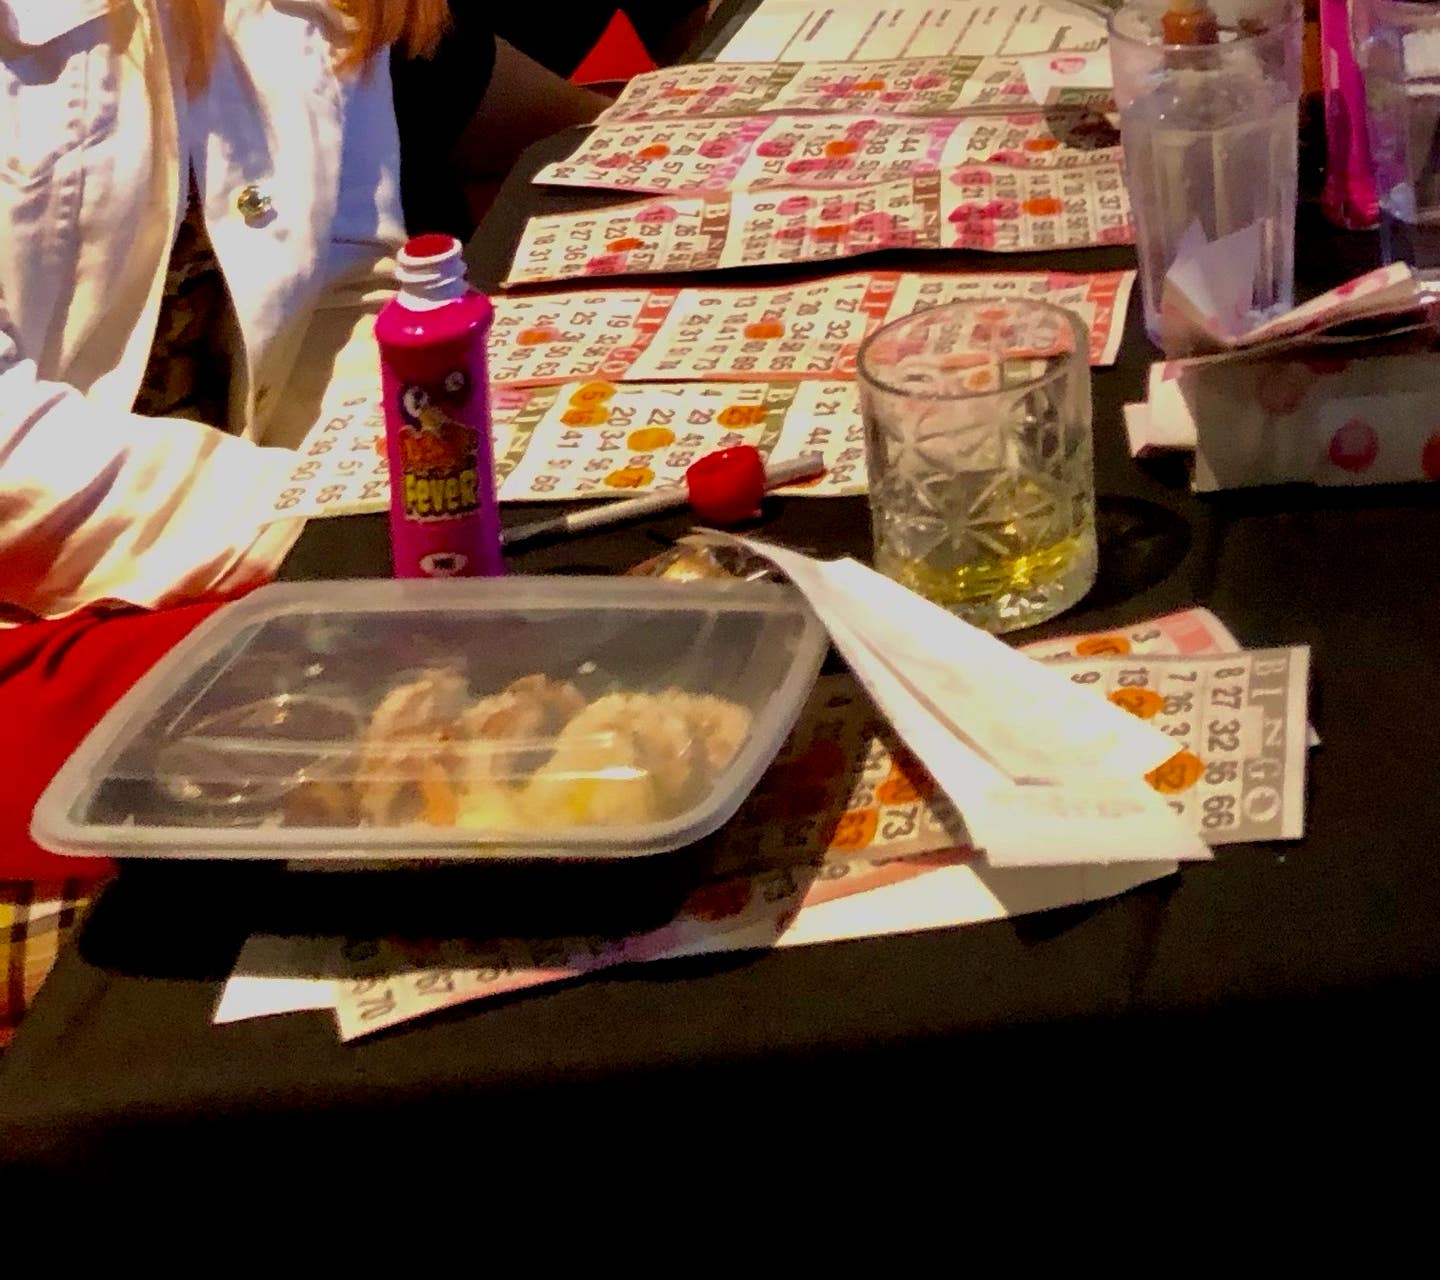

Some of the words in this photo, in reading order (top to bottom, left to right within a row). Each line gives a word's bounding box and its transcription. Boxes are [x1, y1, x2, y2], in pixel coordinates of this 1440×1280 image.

[754, 203, 776, 212] 8
[571, 230, 592, 241] 27
[606, 227, 627, 239] 23
[529, 249, 552, 262] 31
[564, 245, 588, 260] 36
[836, 298, 858, 313] 27
[570, 311, 597, 325] 25
[607, 314, 632, 328] 19
[602, 295, 675, 372] BINGO
[678, 328, 703, 342] 31
[825, 320, 851, 339] 32
[570, 361, 599, 374] 72
[662, 389, 684, 397] 7
[700, 389, 723, 397] 4
[738, 389, 761, 401] 11
[823, 386, 847, 394] 5
[608, 406, 637, 426] 20
[646, 409, 676, 425] 22
[557, 431, 583, 449] 41
[597, 431, 625, 451] 34
[1070, 671, 1101, 685] 9
[1117, 667, 1150, 687] 13
[1167, 671, 1197, 682] 7
[1215, 667, 1246, 679] 8
[1211, 686, 1242, 709] 27
[1209, 719, 1240, 752] 32
[1244, 657, 1289, 822] BINGO
[1206, 761, 1238, 785] 56
[1202, 795, 1236, 829] 66
[881, 805, 918, 840] 73
